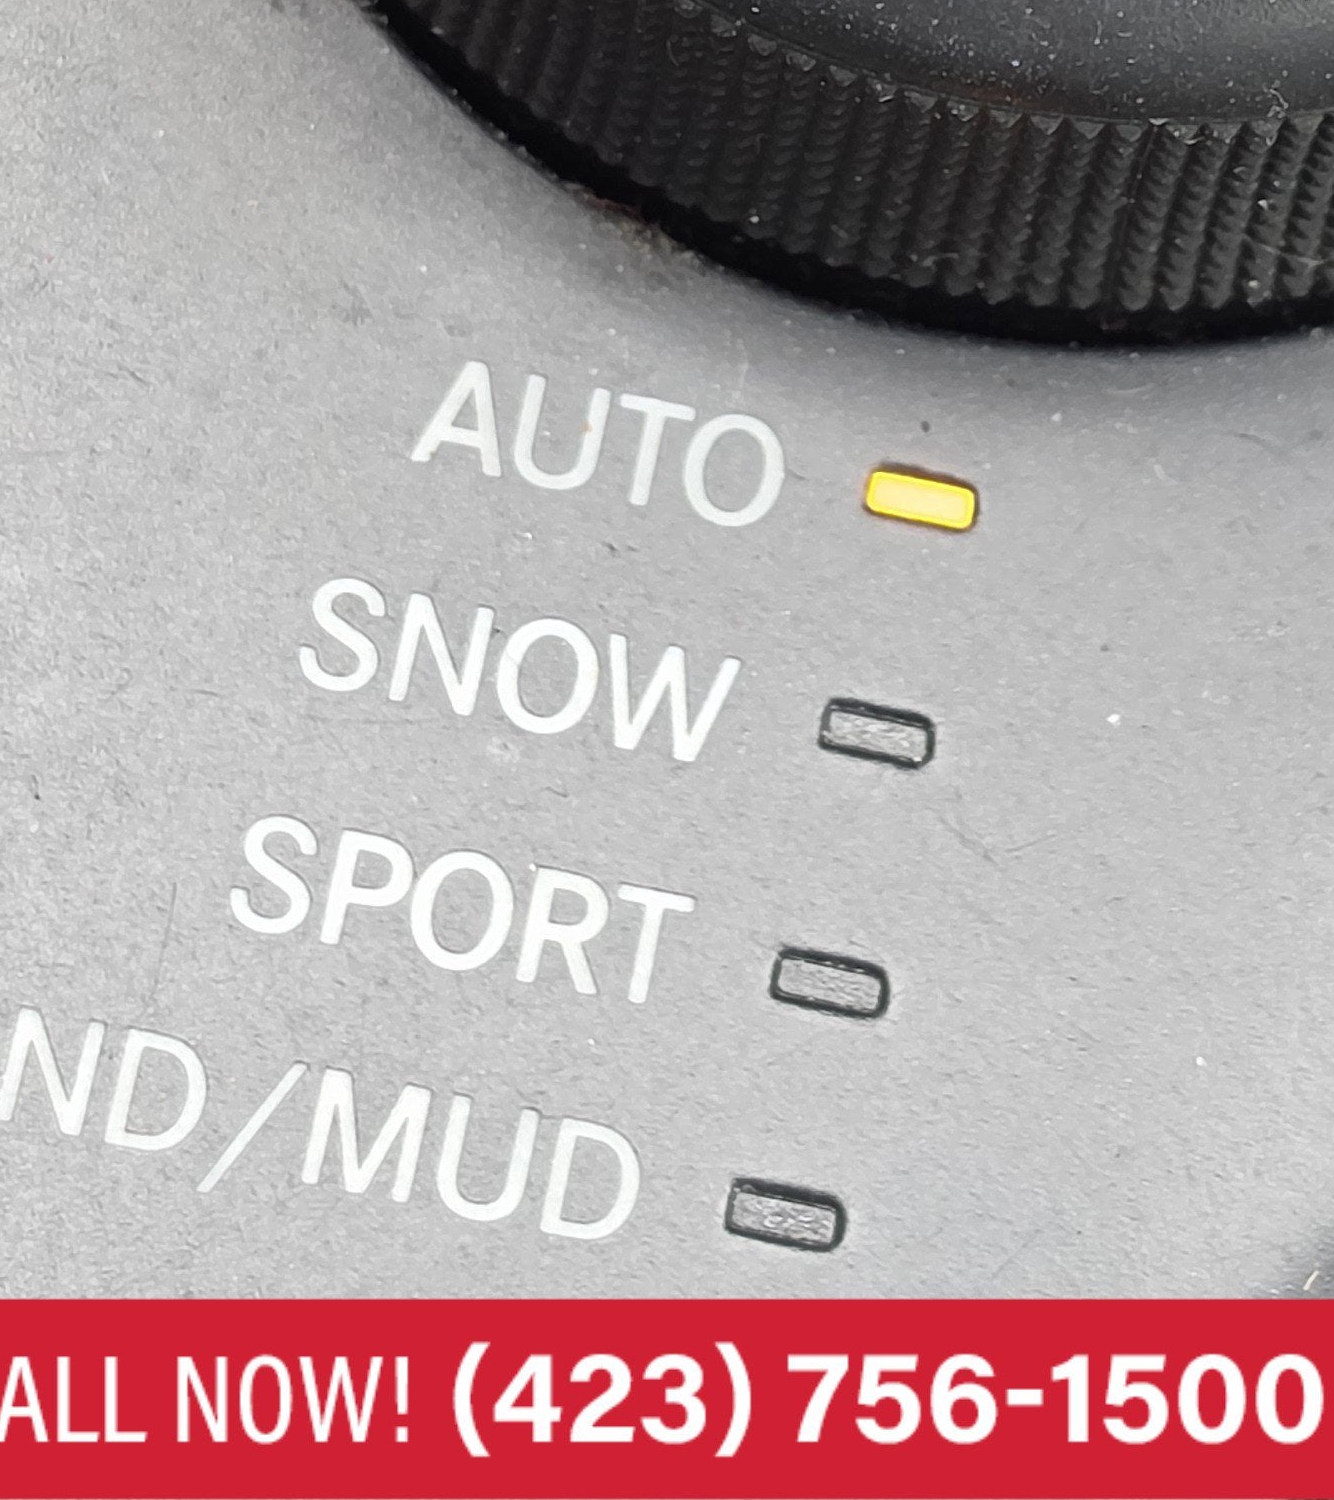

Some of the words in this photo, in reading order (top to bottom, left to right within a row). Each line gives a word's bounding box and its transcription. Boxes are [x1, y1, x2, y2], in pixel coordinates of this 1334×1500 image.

[410, 360, 786, 527] AUTO
[297, 577, 742, 763] SNOW
[229, 814, 696, 1004] SPORT
